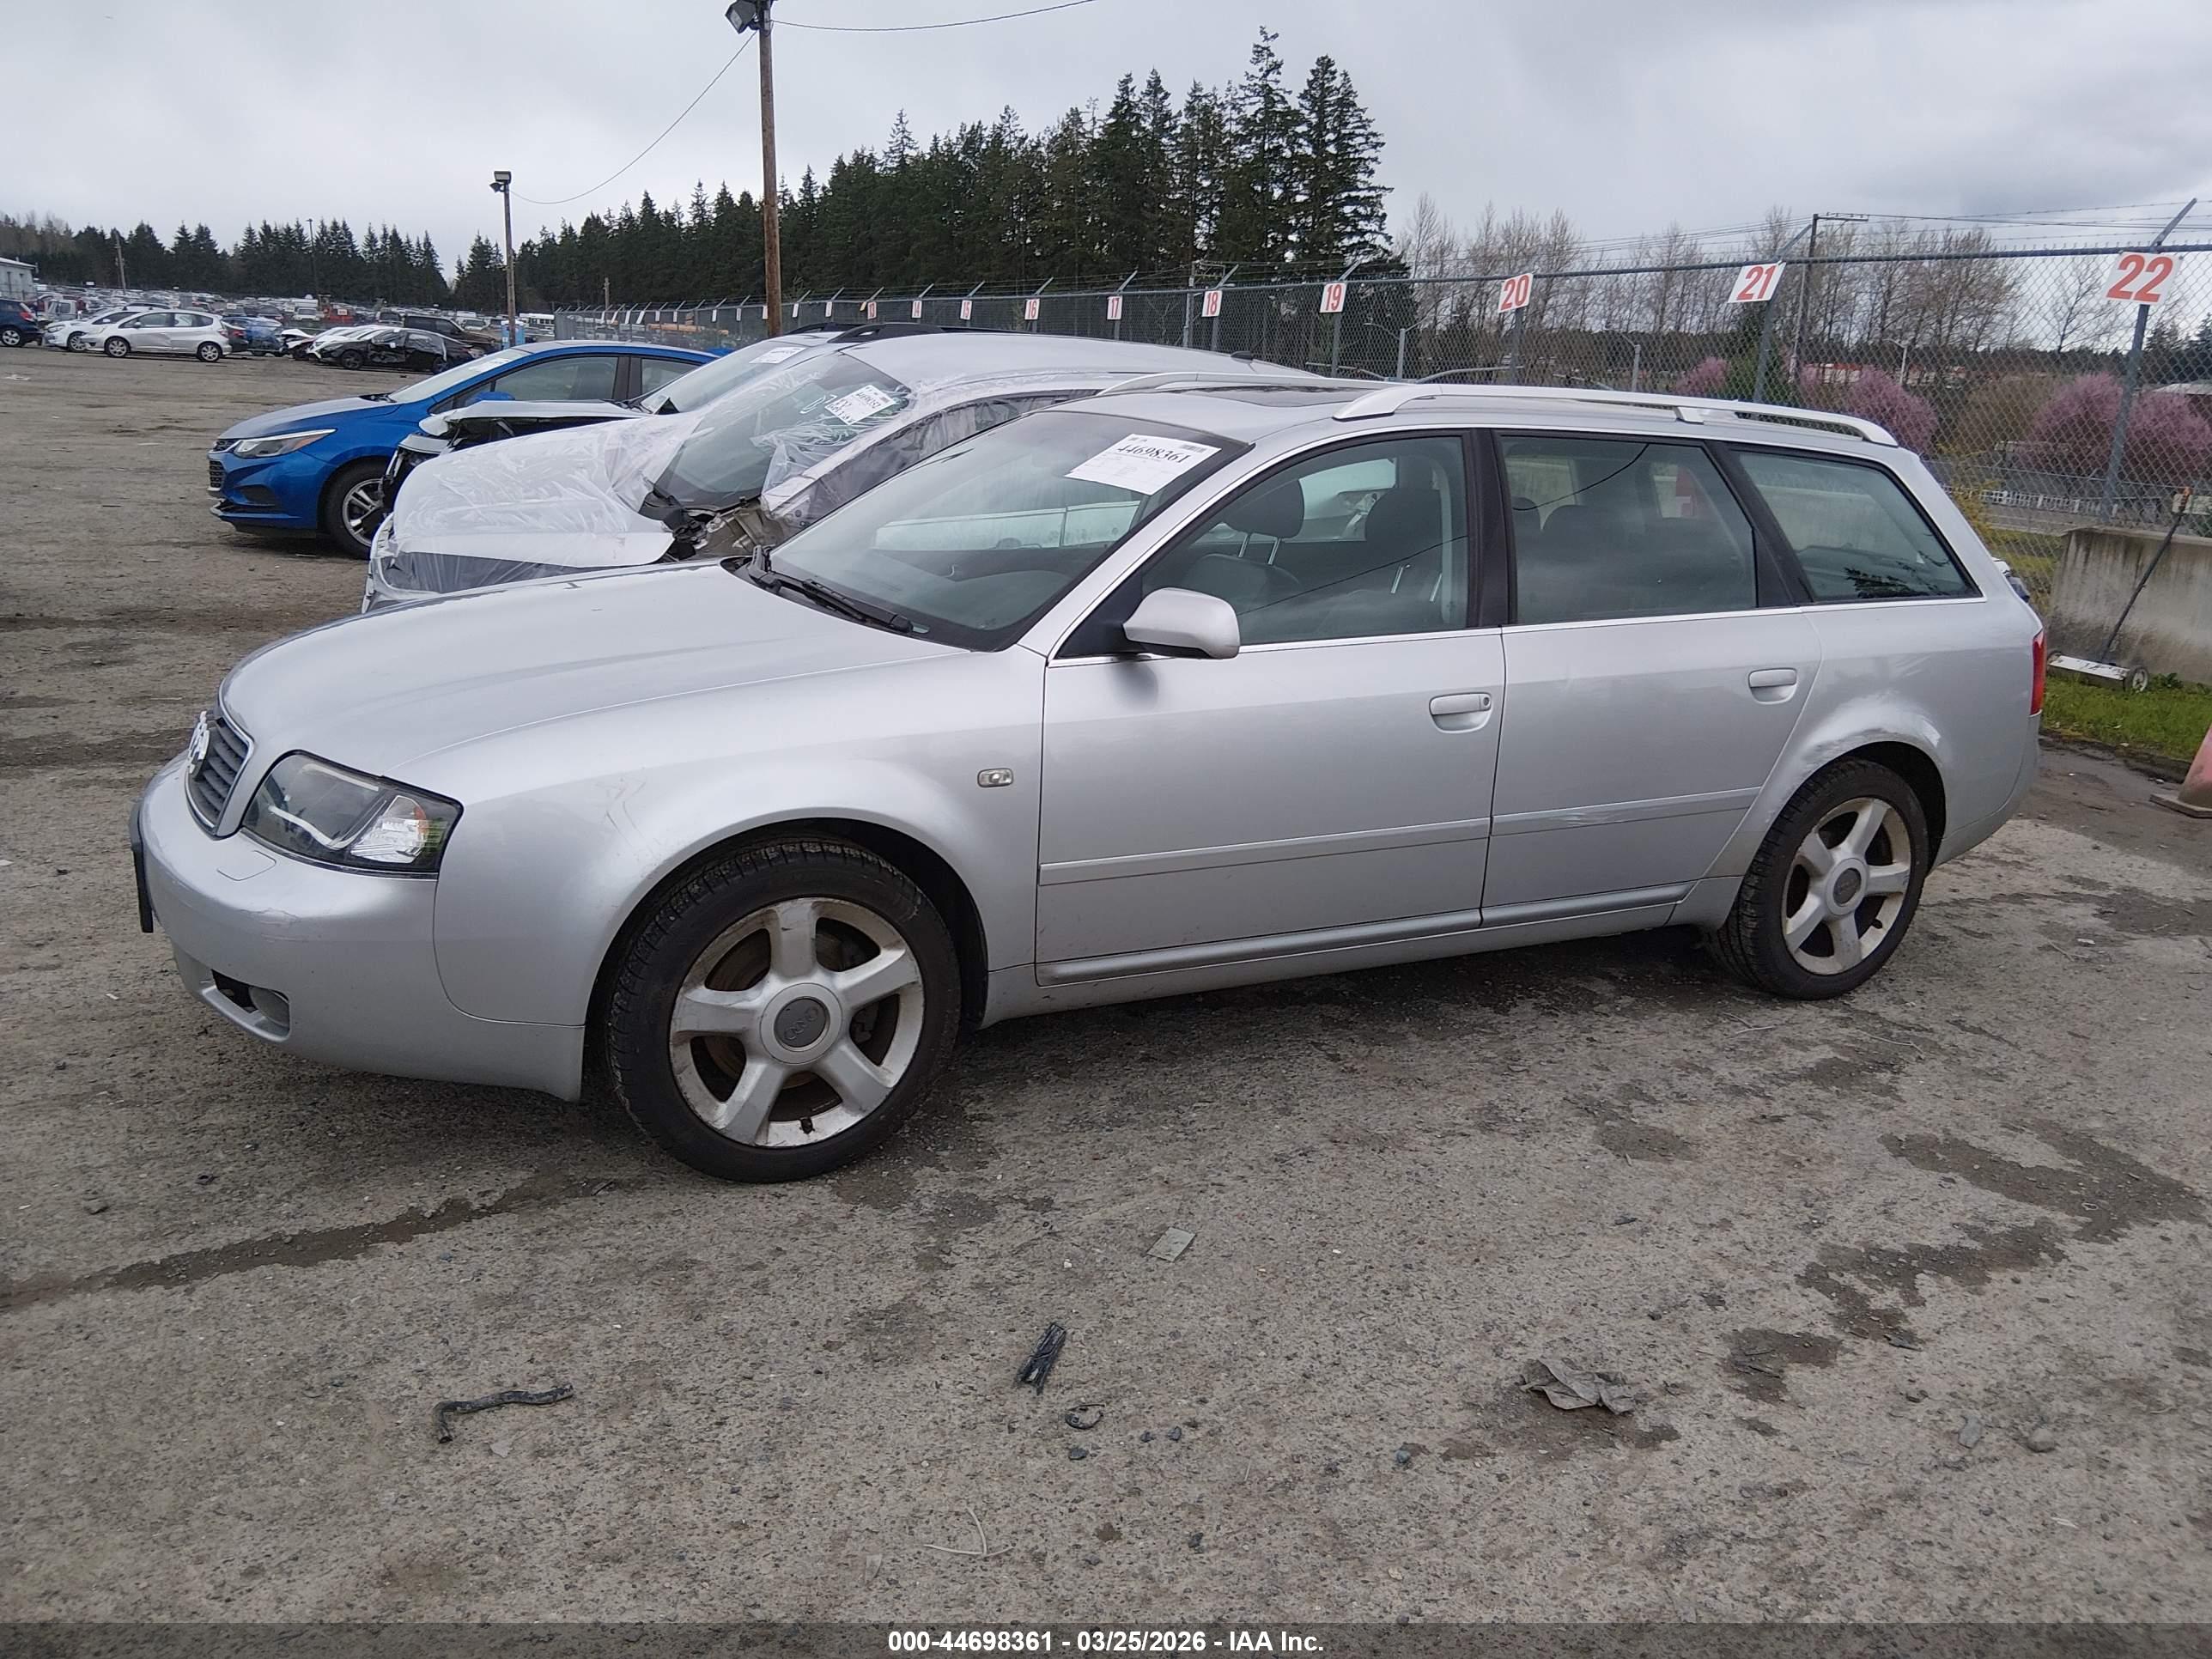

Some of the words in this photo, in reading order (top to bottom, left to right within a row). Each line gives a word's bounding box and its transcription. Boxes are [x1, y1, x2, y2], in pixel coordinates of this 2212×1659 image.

[1736, 265, 1777, 300] 21
[2106, 254, 2173, 302] 22
[1326, 284, 1342, 311] 19
[1501, 275, 1529, 310] 20
[868, 302, 875, 318] 13
[914, 301, 921, 317] 14
[963, 301, 970, 318] 15
[1029, 300, 1037, 318] 16
[1111, 297, 1120, 318] 17
[1206, 292, 1218, 315] 18
[1118, 444, 1192, 464] 44698361
